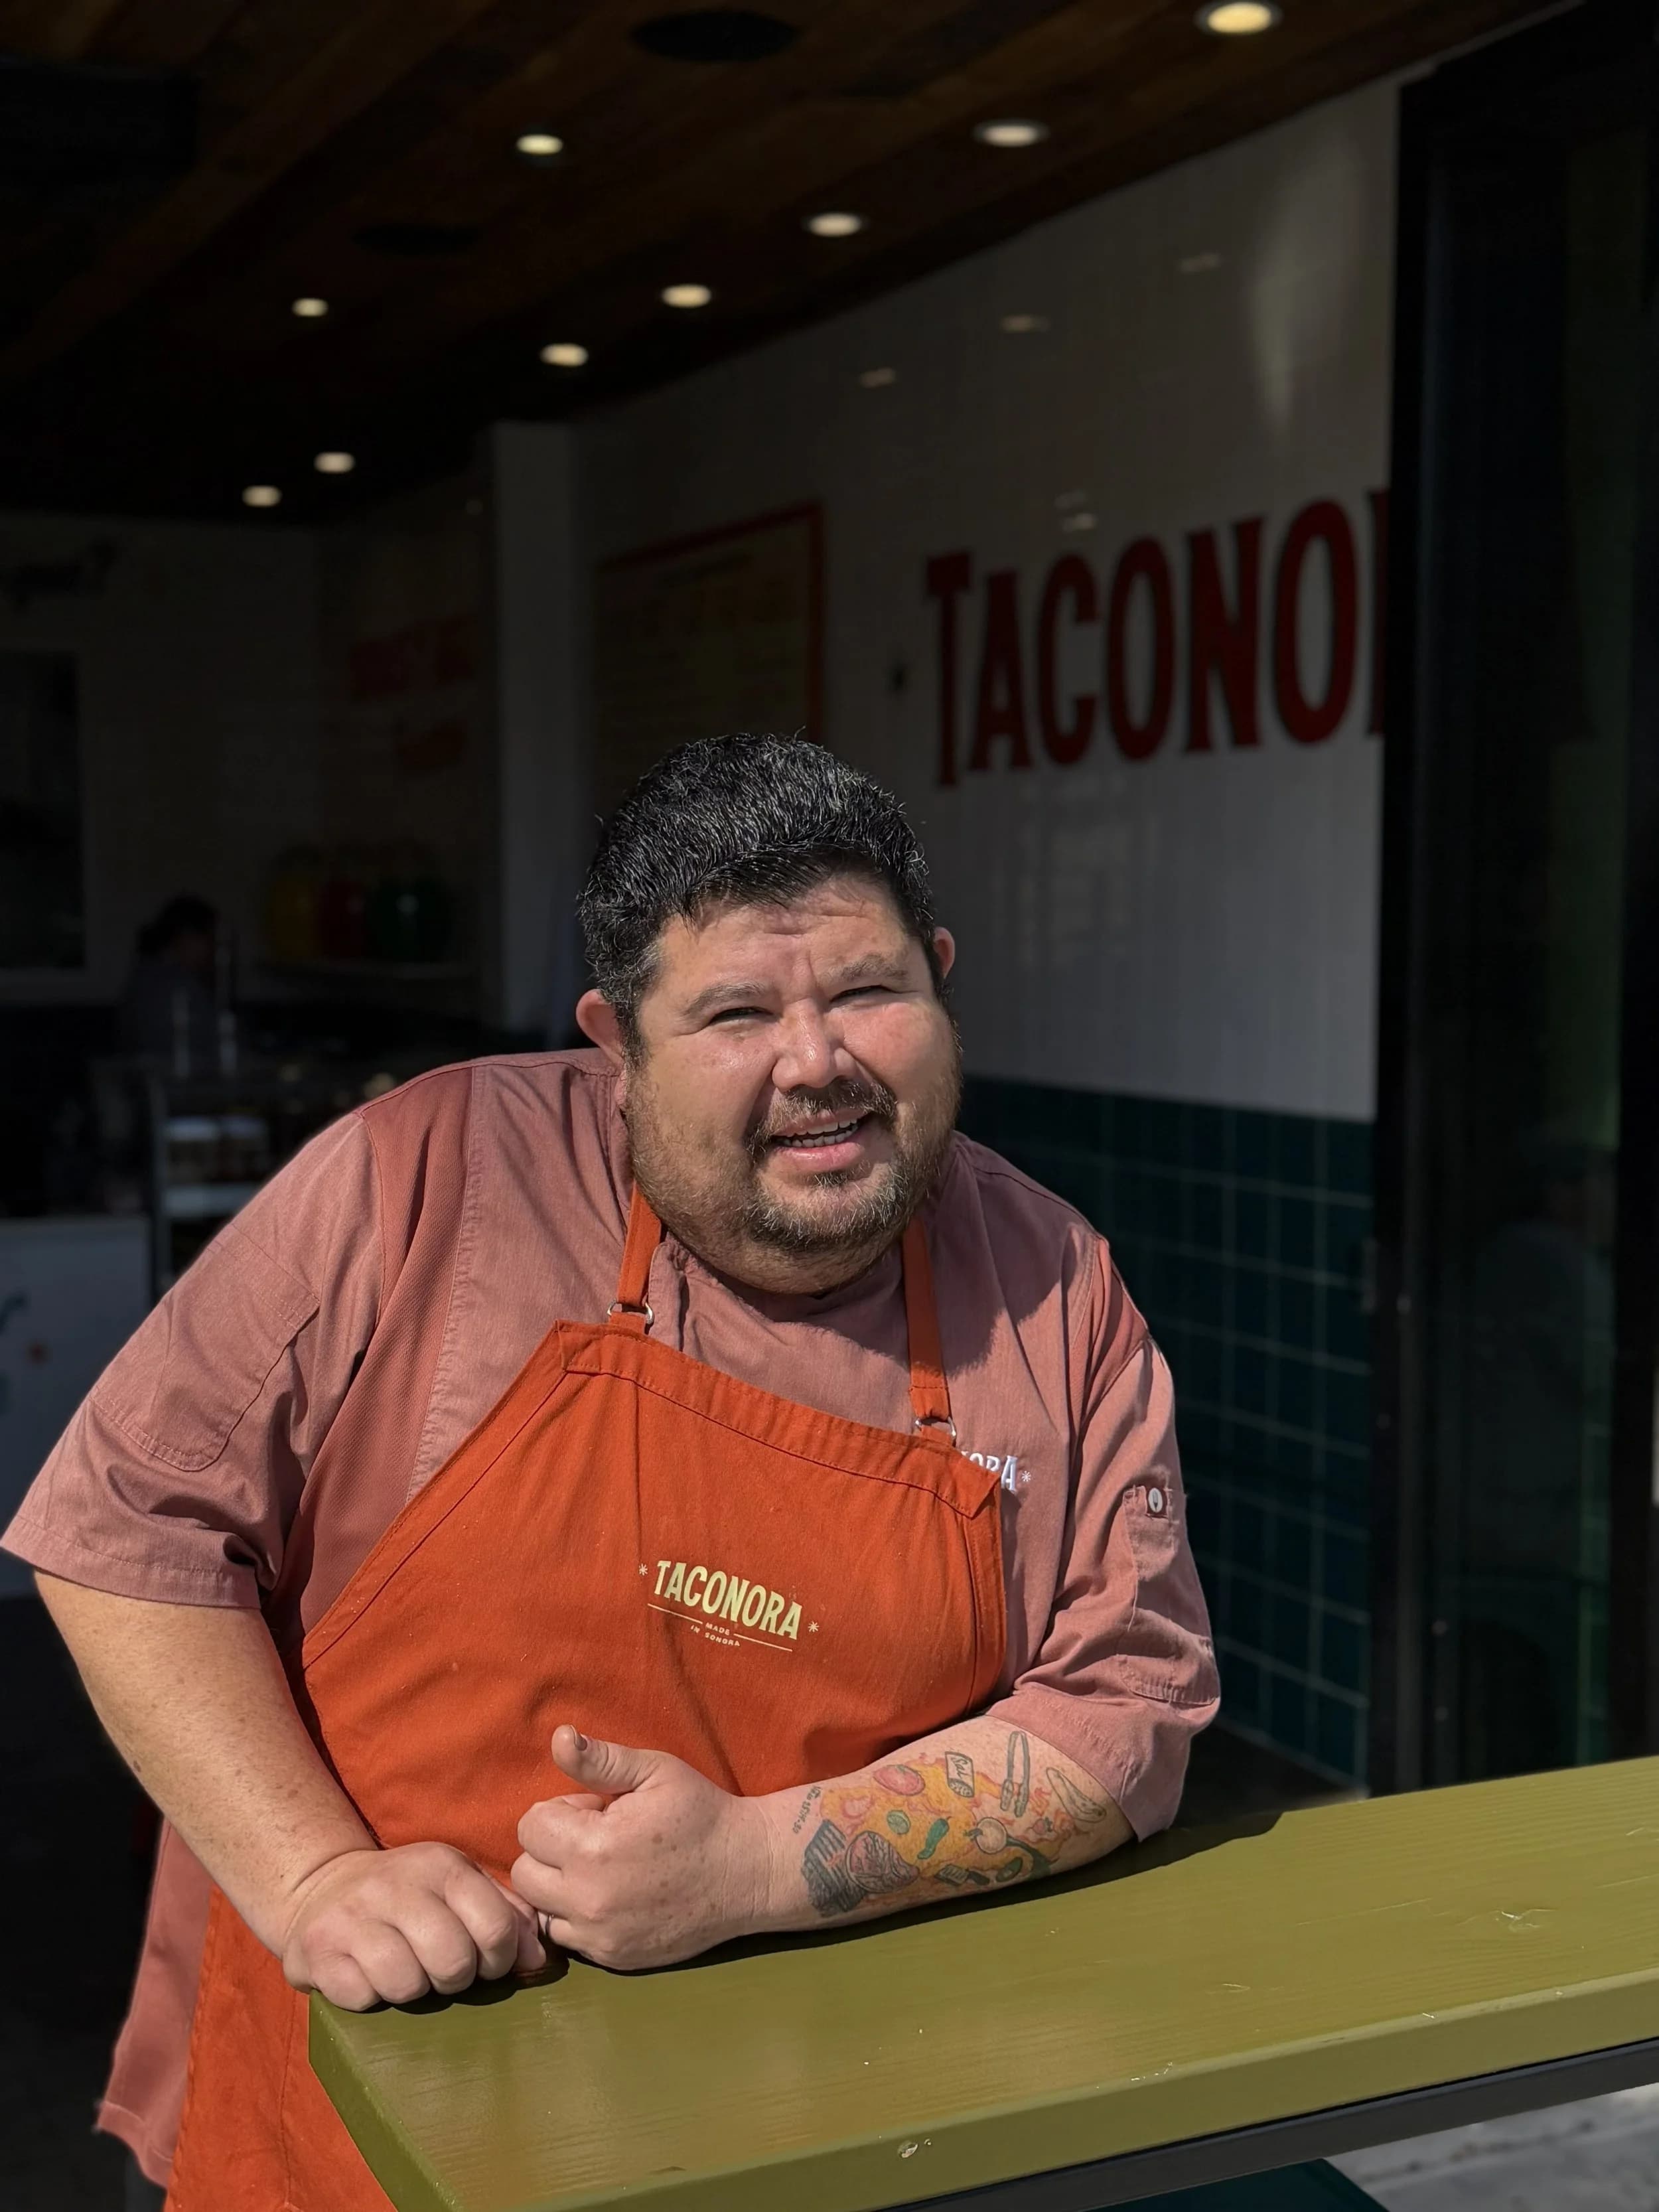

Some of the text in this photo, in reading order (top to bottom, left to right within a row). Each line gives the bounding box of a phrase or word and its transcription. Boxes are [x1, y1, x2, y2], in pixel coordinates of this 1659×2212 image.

[926, 487, 1391, 787] TACONO
[654, 1560, 802, 1641] TACONORA
[690, 1624, 740, 1647] IN SONORA
[705, 1622, 730, 1636] MADE
